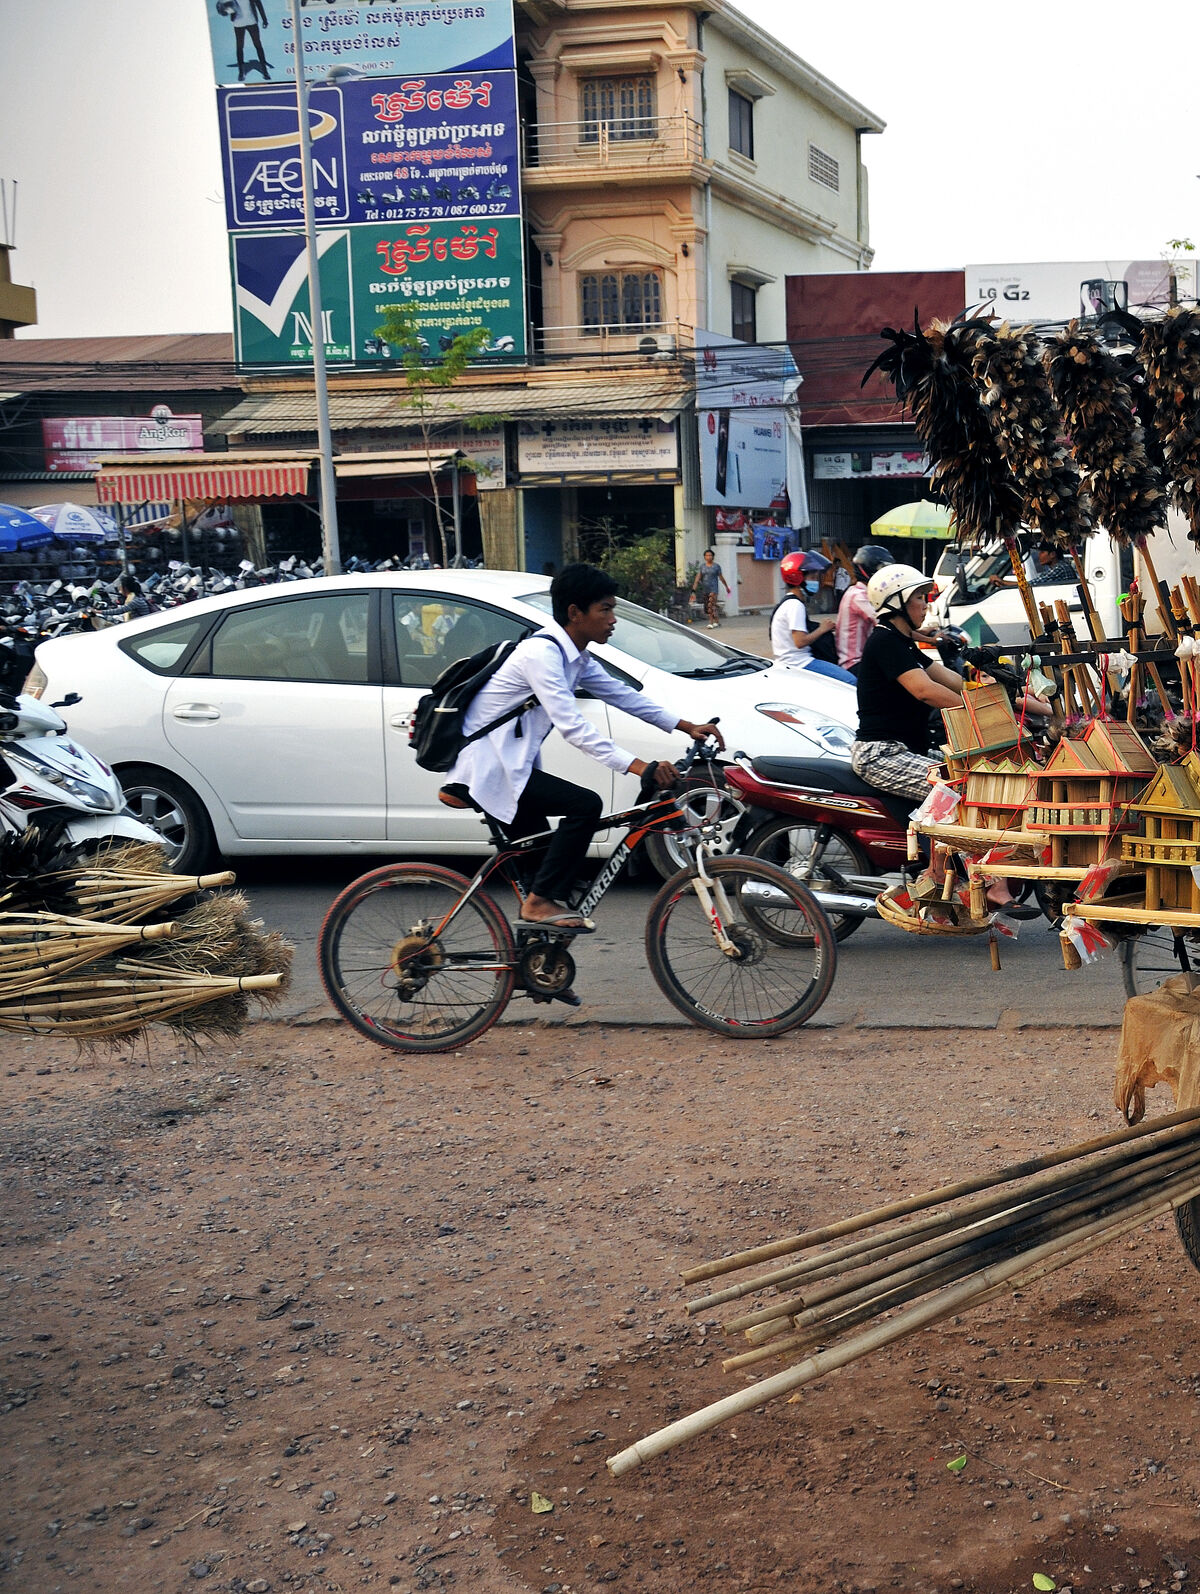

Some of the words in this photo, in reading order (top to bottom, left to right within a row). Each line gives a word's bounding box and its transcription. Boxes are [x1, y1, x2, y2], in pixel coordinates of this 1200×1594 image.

[365, 209, 379, 220] Tel
[386, 208, 403, 218] 012
[405, 207, 417, 218] 75
[418, 206, 430, 217] 75
[431, 206, 443, 216] 78
[451, 204, 468, 215] 087
[469, 203, 487, 214] 600
[488, 203, 507, 213] 527
[979, 288, 997, 299] LG
[1003, 284, 1030, 301] G2
[138, 426, 187, 441] Angkor
[579, 842, 632, 918] BARCELONA
